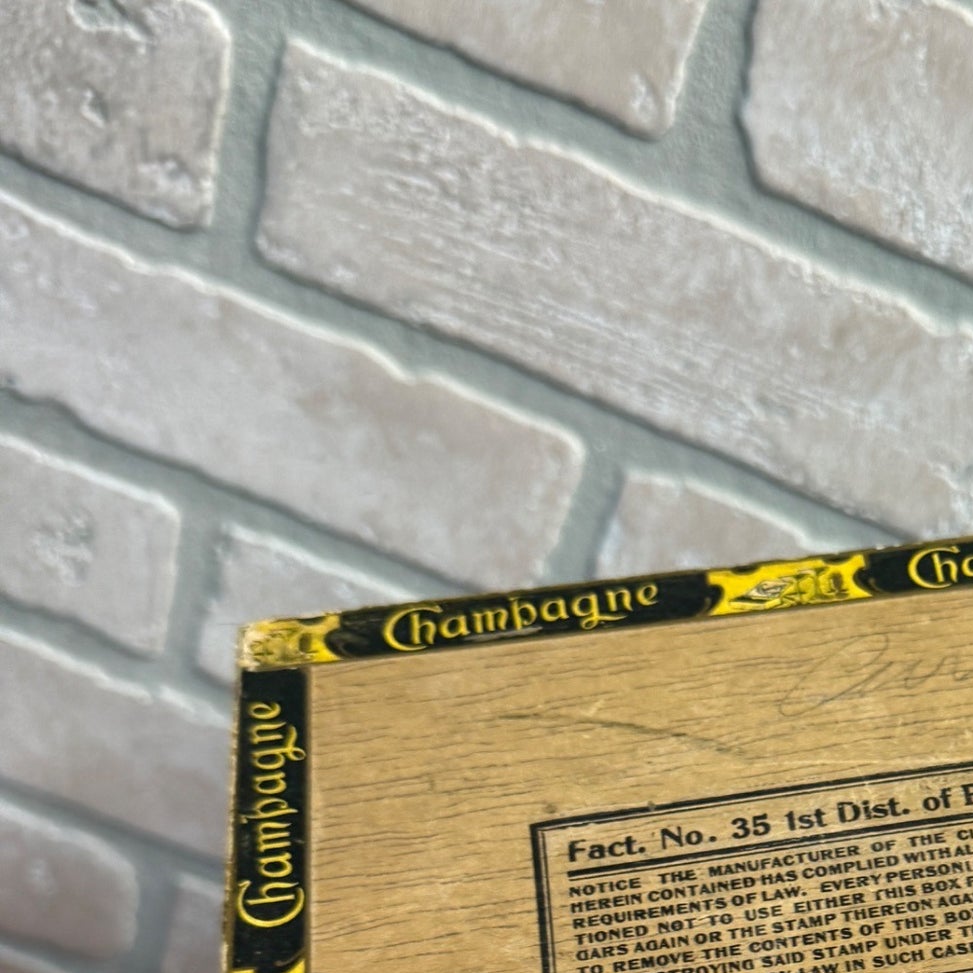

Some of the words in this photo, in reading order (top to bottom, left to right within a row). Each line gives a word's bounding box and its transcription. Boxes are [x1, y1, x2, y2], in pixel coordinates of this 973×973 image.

[382, 582, 660, 651] Champagne
[236, 700, 307, 929] Champagne
[567, 835, 646, 863] Fact.
[660, 826, 717, 850] No.
[731, 813, 771, 840] 35
[784, 808, 828, 831] 1st
[837, 797, 911, 823] Dist.
[922, 787, 952, 812] of
[569, 877, 641, 898] NOTICE
[657, 869, 698, 885] THE
[708, 845, 860, 877] MANUFACTURER
[870, 839, 896, 853] OF
[907, 832, 947, 848] THE
[570, 892, 643, 914] HEREIN
[647, 876, 756, 903] CONTAINED
[760, 870, 798, 886] HAS
[802, 855, 900, 880] COMPLIED
[572, 897, 727, 930] REQUIREMENTS
[730, 892, 757, 907] OF
[761, 885, 807, 902] LAW.
[820, 874, 882, 893] EVERY
[574, 925, 649, 946] TIONED
[657, 917, 696, 935] NOT
[706, 913, 734, 926] TO
[744, 904, 784, 922] USE
[794, 892, 866, 914] EITHER
[875, 885, 917, 901] THIS
[921, 878, 962, 894] BOX
[634, 935, 690, 953] AGAIN
[693, 931, 722, 945] OR
[727, 924, 767, 940] THE
[772, 913, 837, 934] STAMP
[840, 898, 933, 922] THEREON
[612, 951, 695, 973] REMOVE
[701, 944, 742, 960] THE
[748, 927, 854, 953] CONTENTS
[859, 922, 885, 937] OF
[891, 914, 938, 931] THIS
[761, 951, 805, 968] SAID
[812, 940, 878, 961] STAMP
[884, 928, 952, 950] UNDER
[845, 958, 866, 972] IN
[872, 949, 925, 968] SUCH
